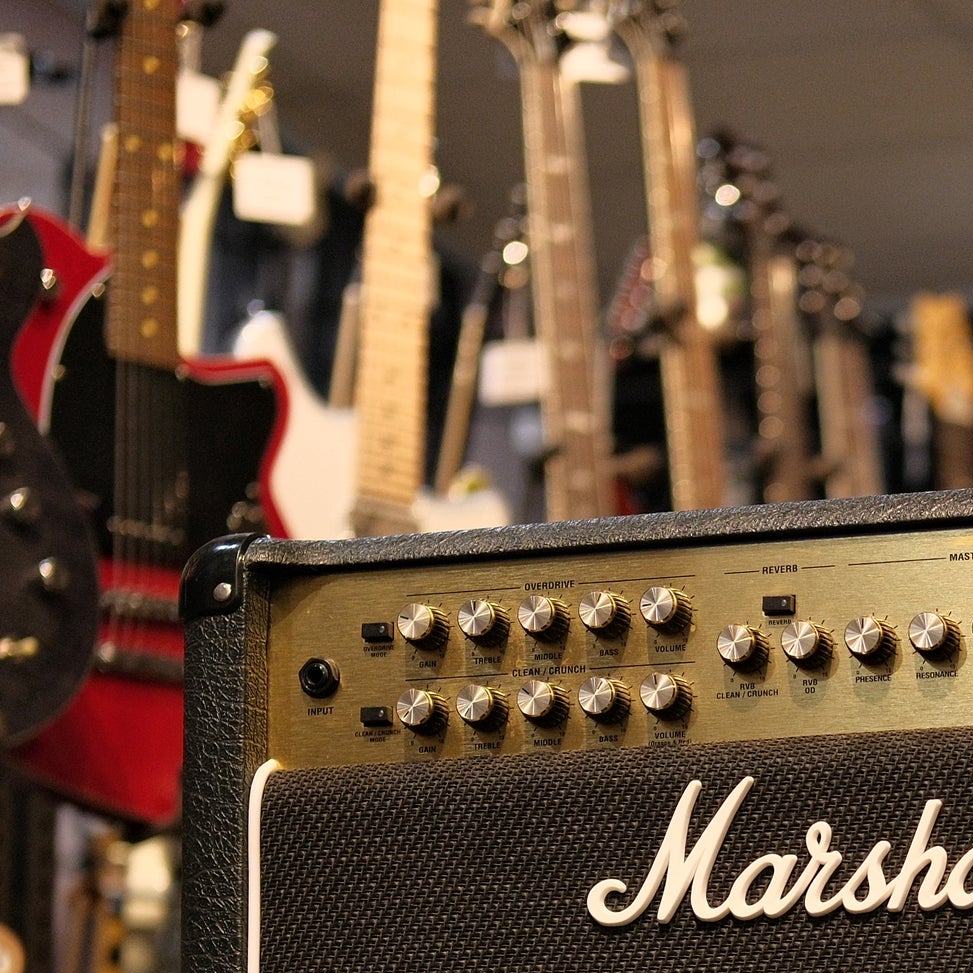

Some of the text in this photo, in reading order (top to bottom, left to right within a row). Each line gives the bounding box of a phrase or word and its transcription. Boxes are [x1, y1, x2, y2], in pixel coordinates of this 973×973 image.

[762, 564, 798, 575] REVERB
[524, 580, 575, 591] OVERDRIVE
[599, 648, 620, 657] BASS
[654, 644, 687, 653] VOLUME
[474, 655, 501, 665] TREBLE
[534, 652, 562, 661] MIDDLE
[419, 660, 437, 668] GAIN
[512, 668, 541, 678] CLEAN
[549, 665, 586, 675] CRUNCH
[915, 670, 959, 679] RESONANCE
[855, 675, 892, 683] PRESENCE
[716, 691, 741, 699] CLEAN
[749, 689, 779, 698] CRUNCH
[804, 686, 816, 694] OD
[307, 706, 334, 716] INPUT
[599, 734, 619, 743] BASS
[654, 730, 686, 740] VOLUME
[473, 742, 501, 750] TREBLE
[533, 738, 562, 747] MIDDLE
